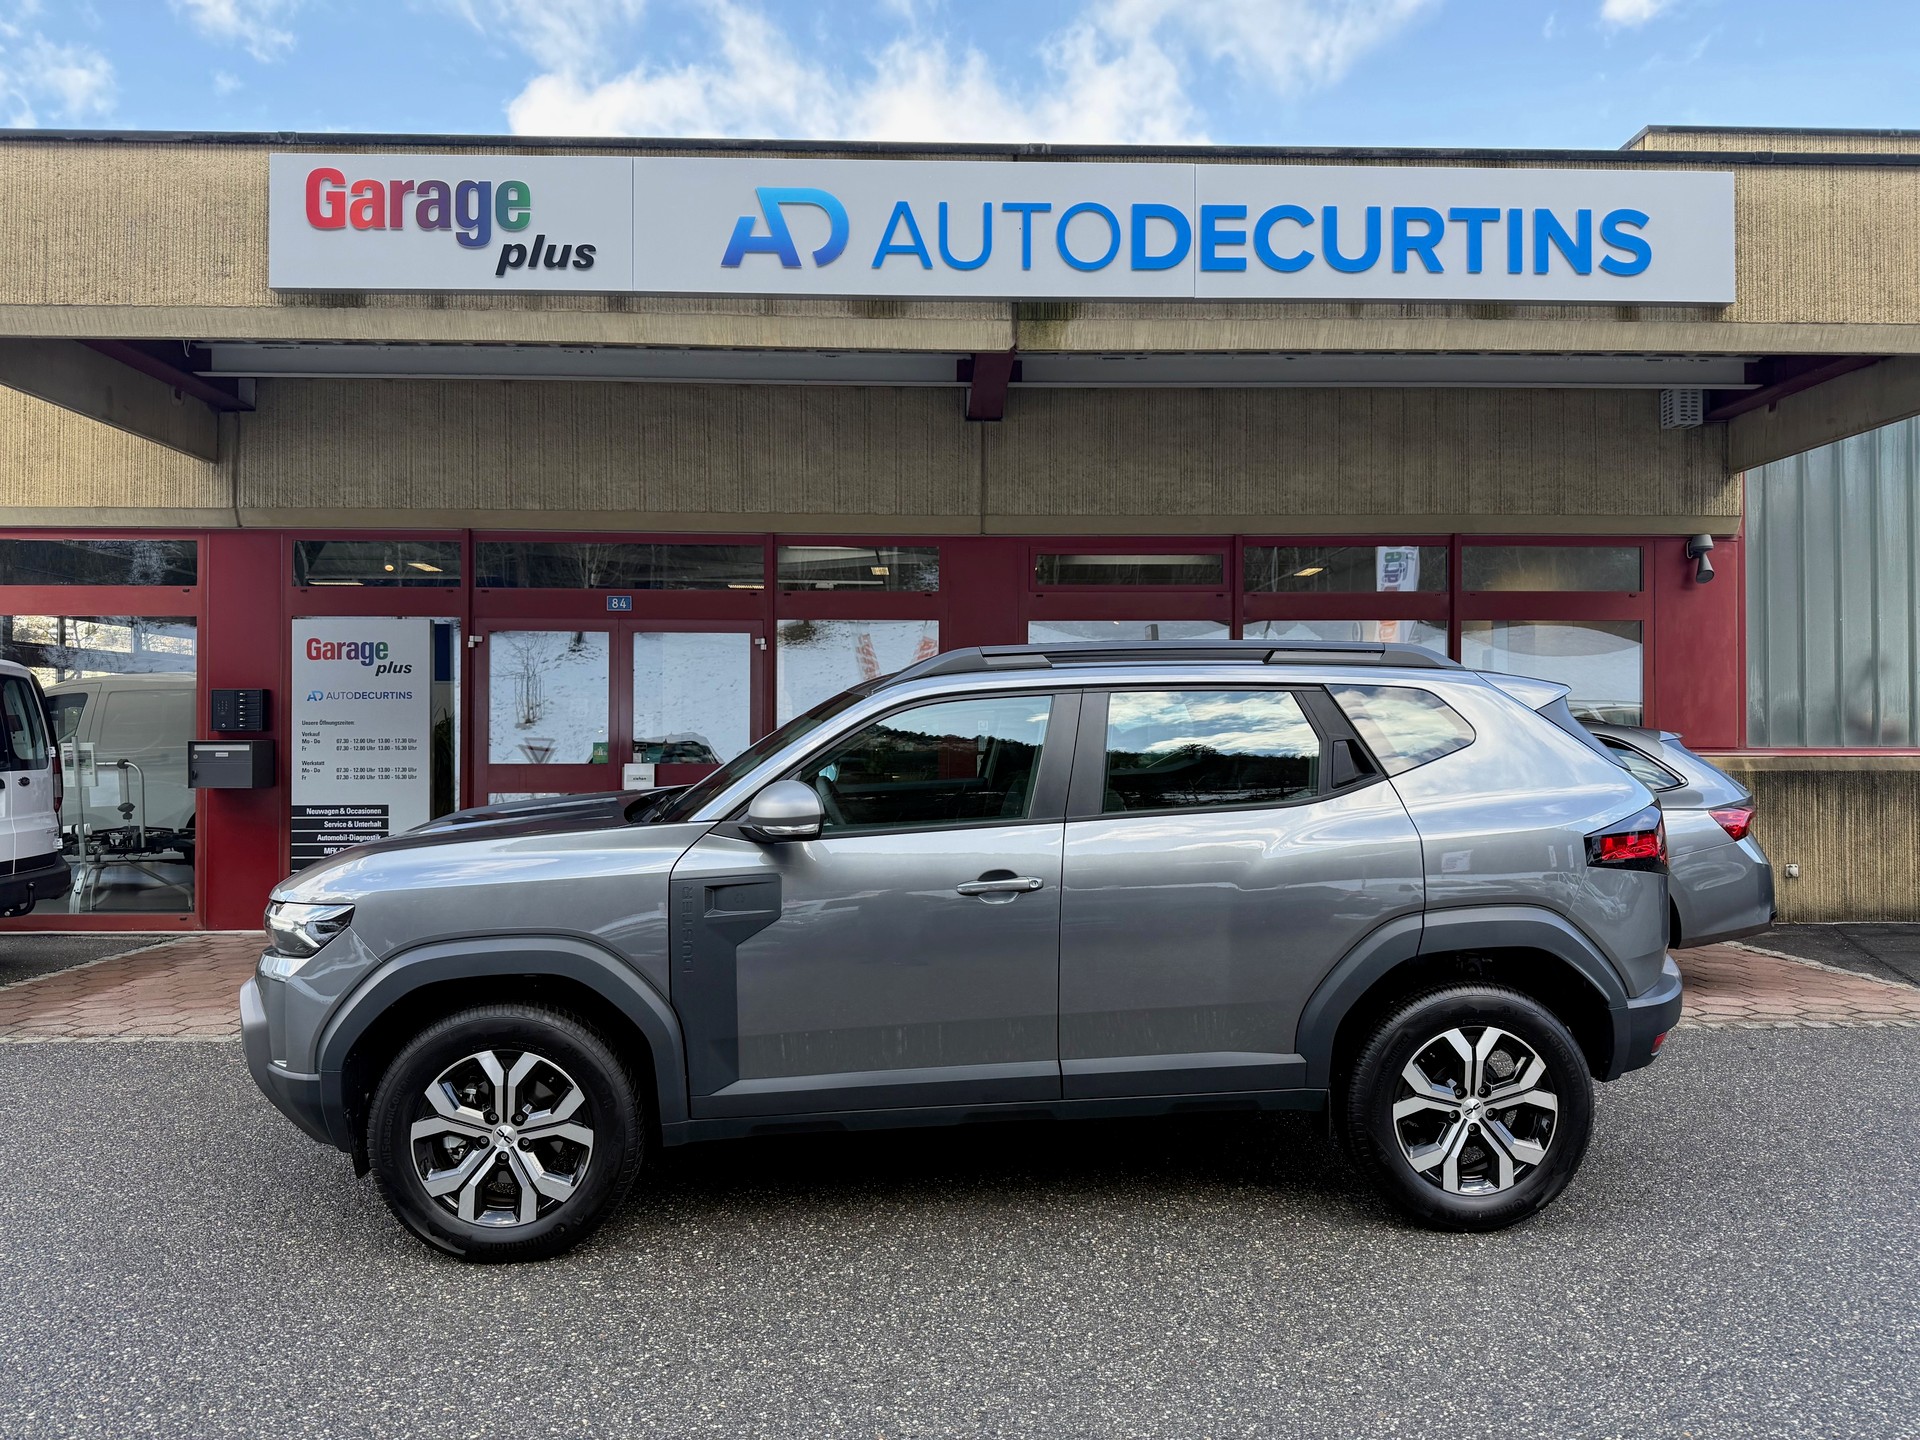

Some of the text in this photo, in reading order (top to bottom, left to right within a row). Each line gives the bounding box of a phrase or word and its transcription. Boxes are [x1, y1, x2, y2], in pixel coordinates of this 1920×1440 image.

[304, 166, 532, 248] Garage
[871, 201, 1653, 277] AUTODECURTINS
[495, 234, 597, 276] plus
[611, 598, 627, 609] 84
[306, 637, 389, 667] Garage
[375, 661, 412, 677] plus
[326, 691, 413, 700] AUTODECURTINS
[306, 807, 339, 816] Neuwagen
[346, 807, 382, 815] Occasionen
[323, 820, 382, 828] Service & Unterhalt
